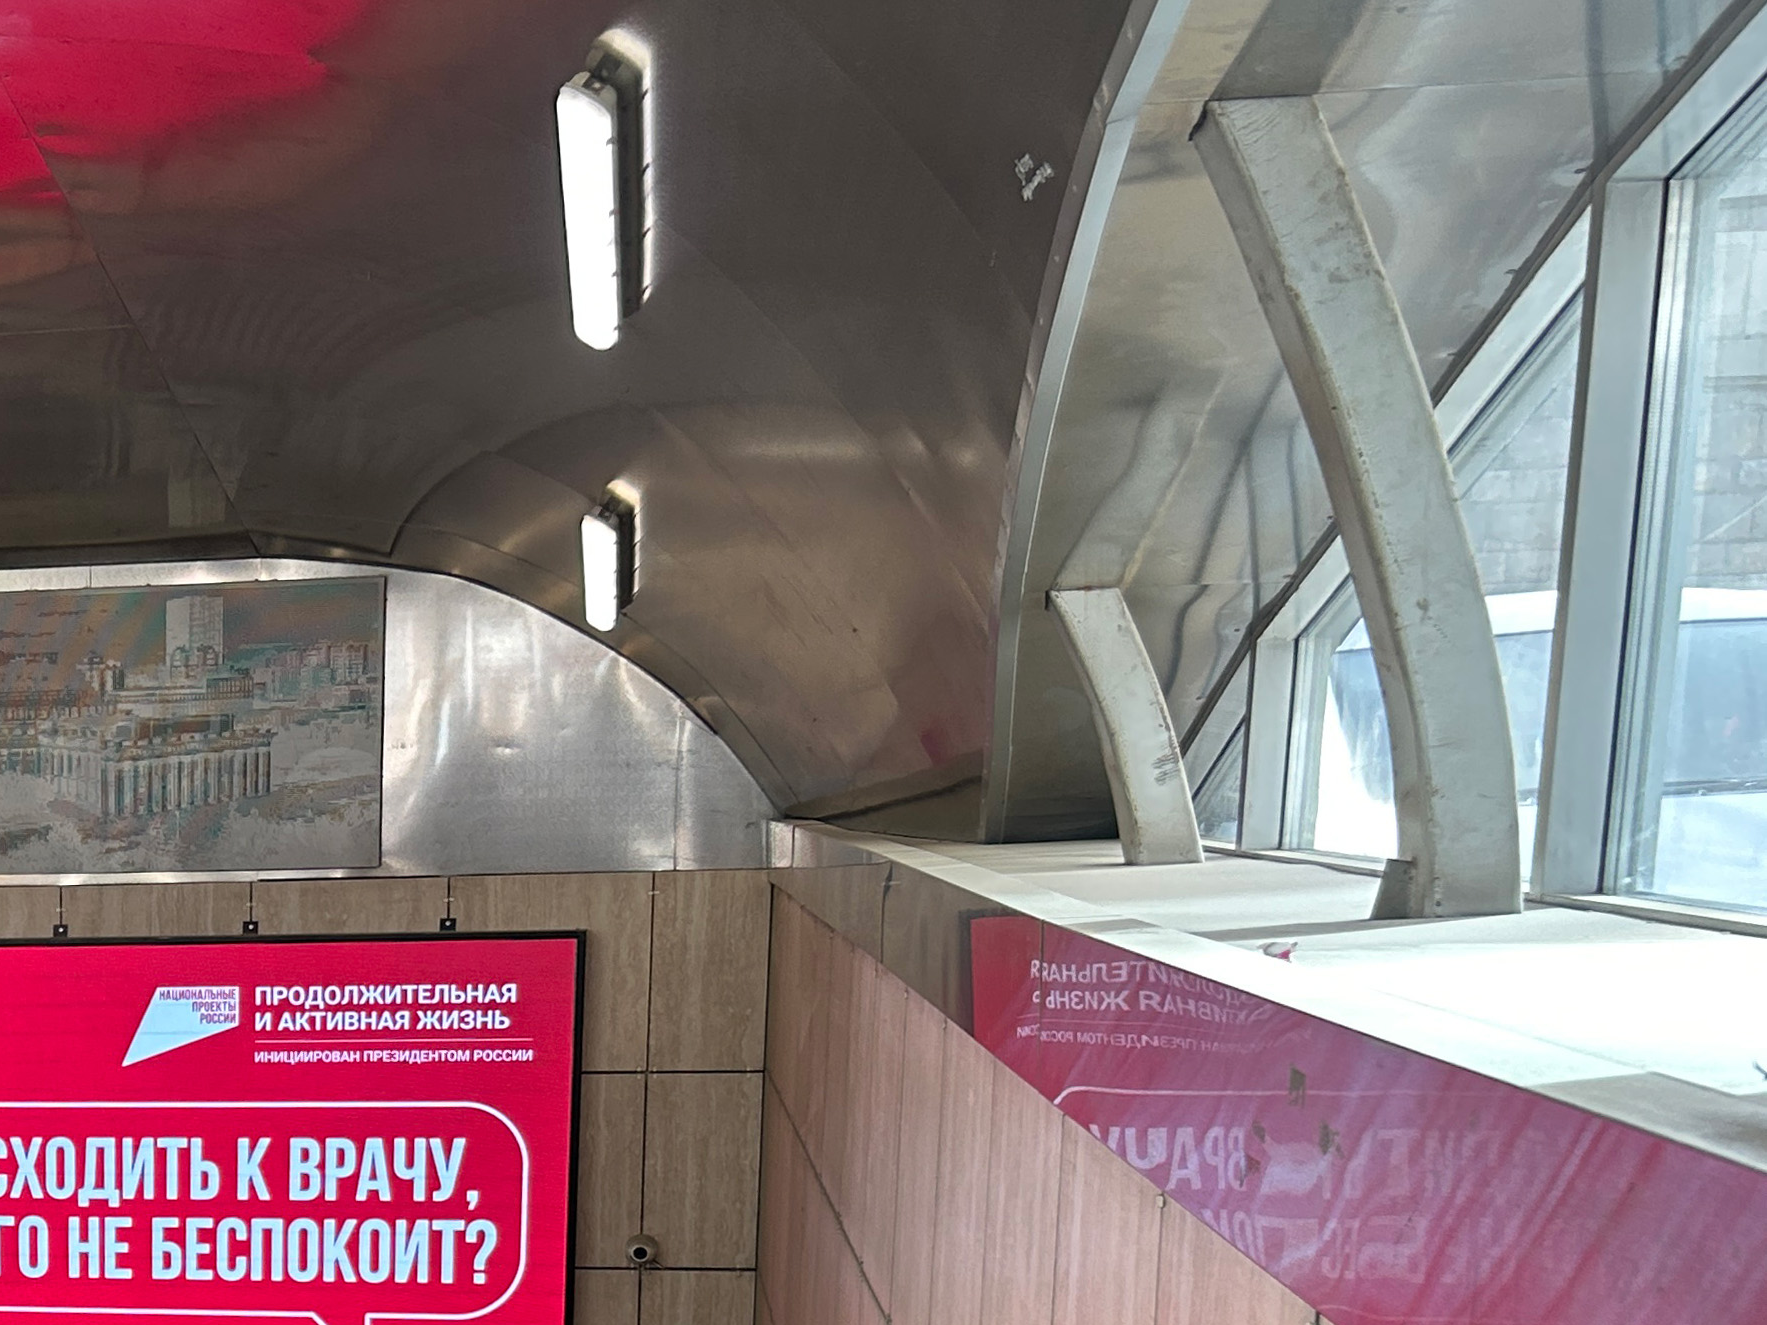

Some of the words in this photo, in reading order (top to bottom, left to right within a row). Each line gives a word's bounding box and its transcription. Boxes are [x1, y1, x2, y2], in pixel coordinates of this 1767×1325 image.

[159, 989, 237, 1001] НАЦИОНАЛЬНЫЕ
[255, 984, 518, 1009] ПРОДОЛЖИТЕЛЬНАЯ
[191, 1001, 237, 1013] ПРОЕКТЫ
[199, 1012, 237, 1025] РОССИИ
[255, 1012, 272, 1031] И
[278, 1010, 411, 1032] АКТИВНАЯ
[417, 1010, 510, 1029] ЖИЗНЬ
[255, 1051, 360, 1064] ИНИЦИИРОВАН
[364, 1050, 470, 1064] ПРЕЗИДЕНТОМ
[474, 1049, 533, 1061] РОССИИ
[237, 1137, 271, 1200] К
[289, 1137, 478, 1210] ВРАЧУ,
[68, 1216, 132, 1279] НЕ
[152, 1217, 497, 1284] БЕСПОКОИТ?
